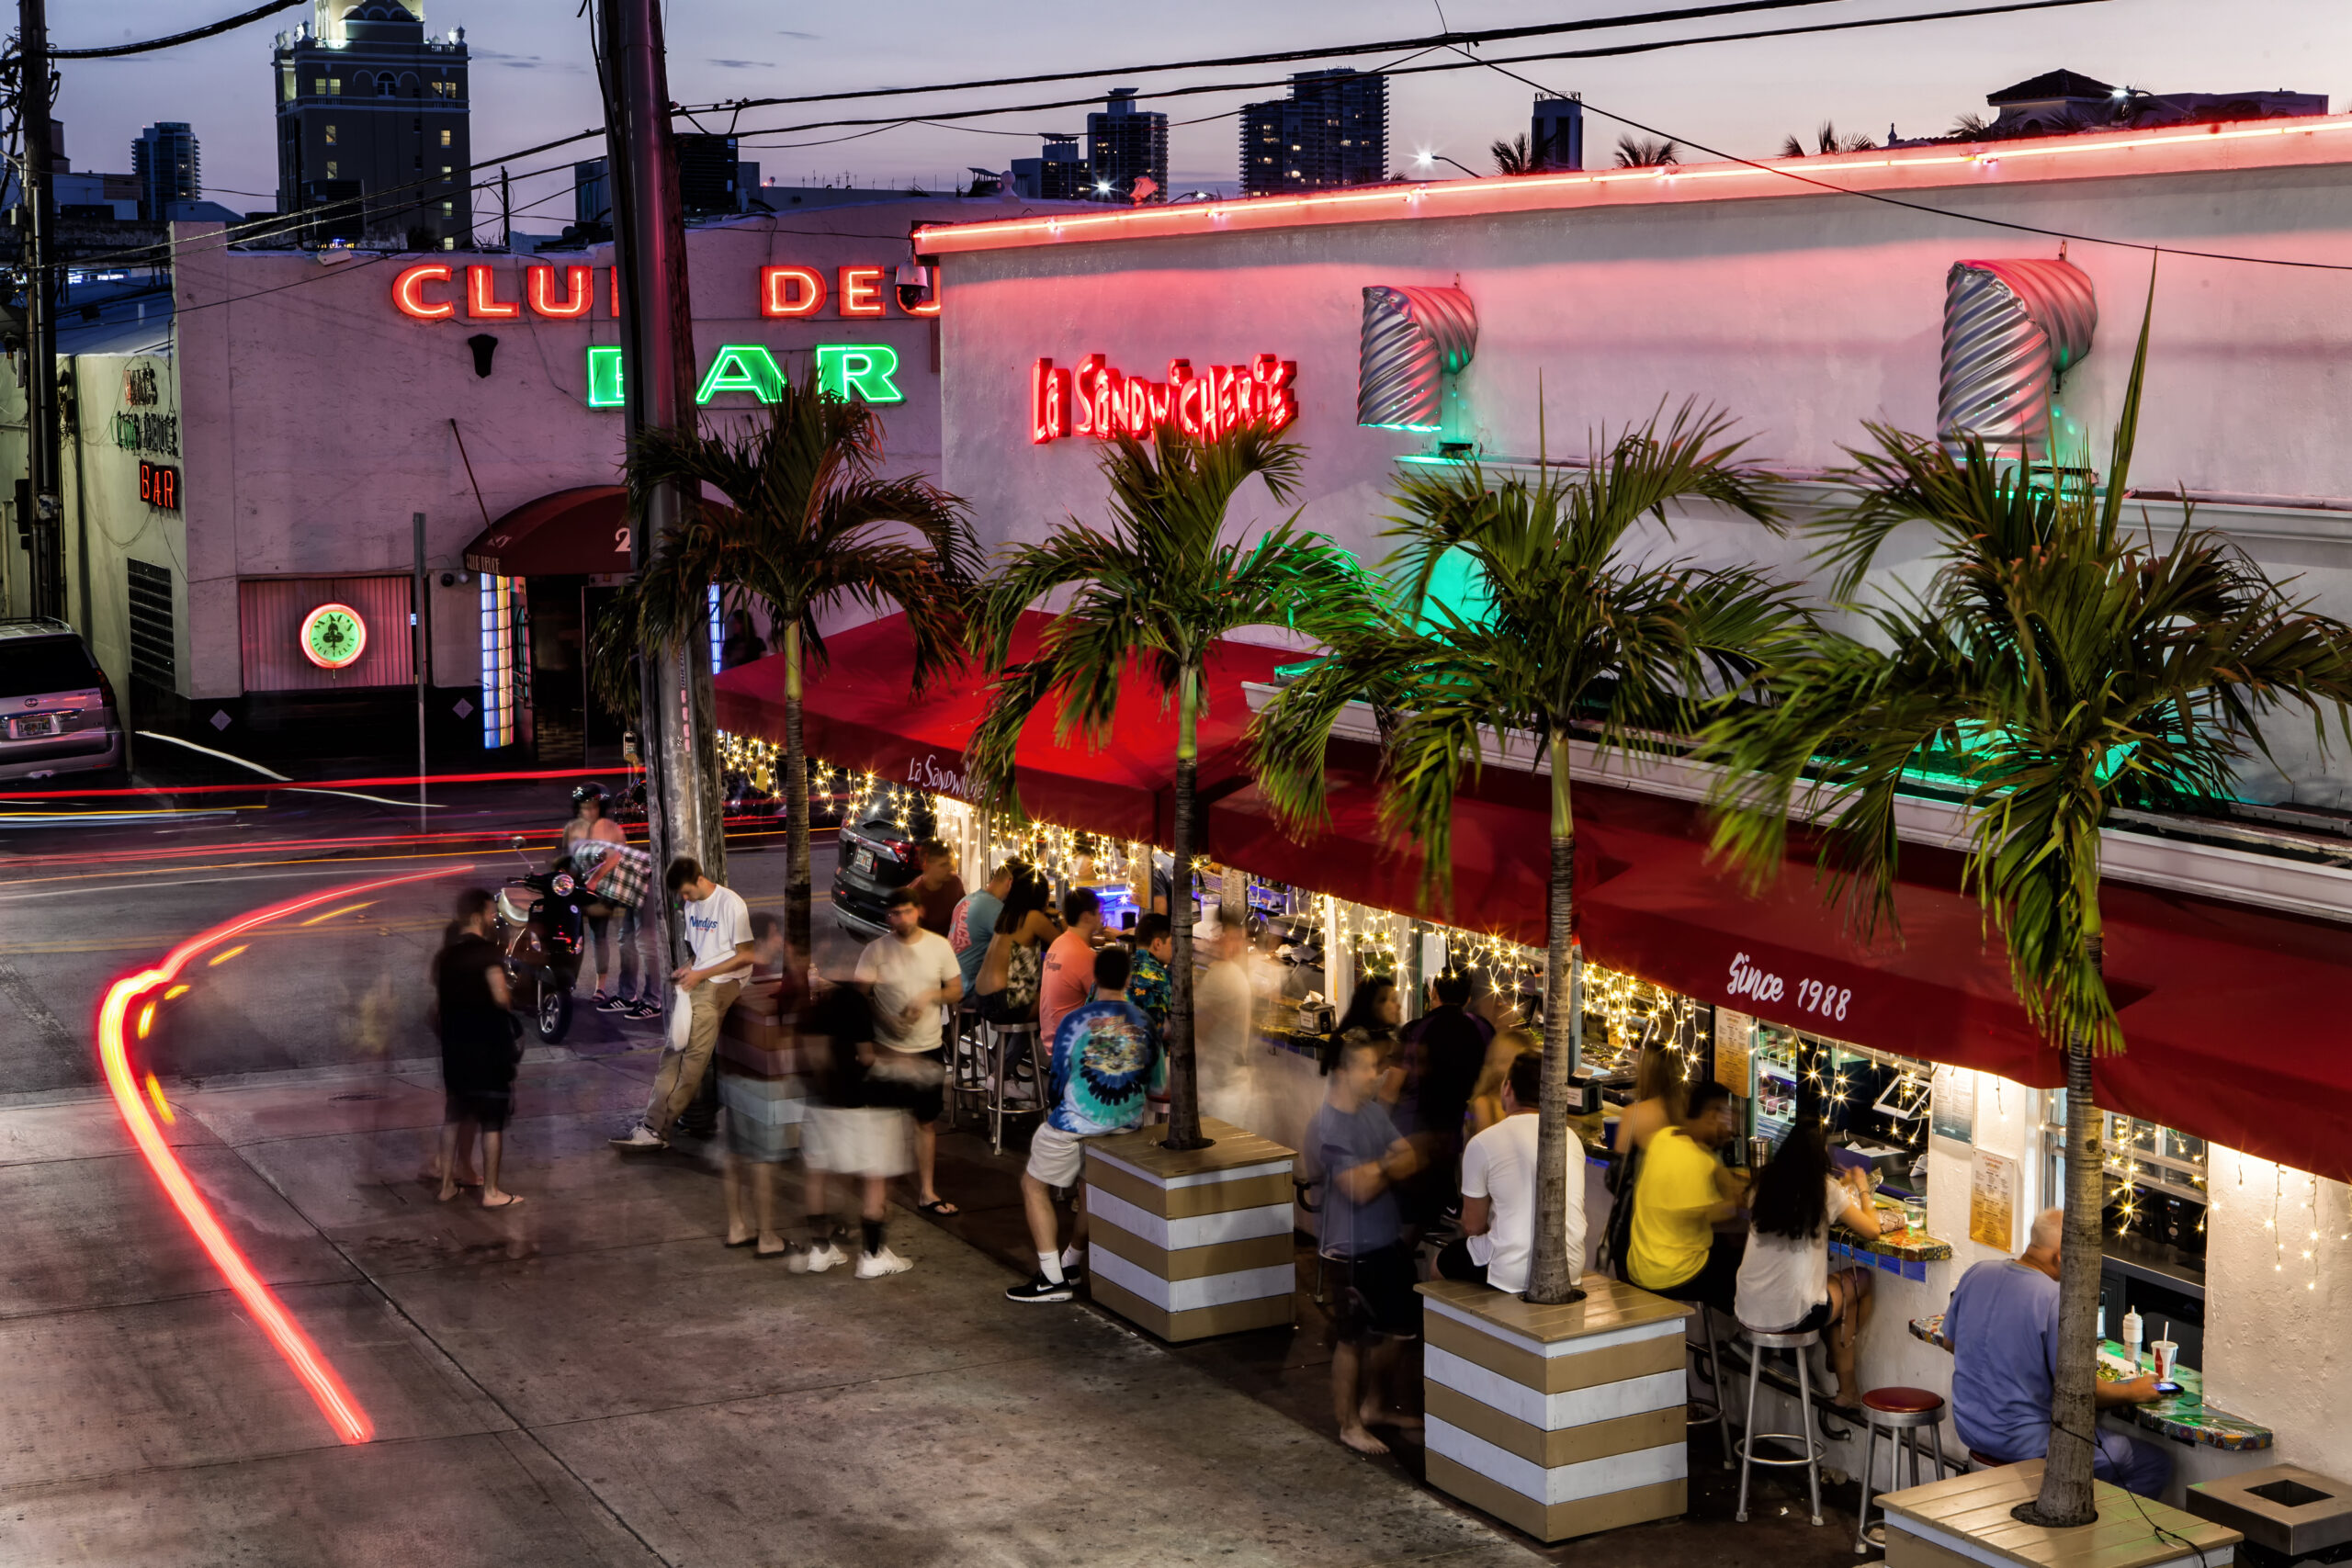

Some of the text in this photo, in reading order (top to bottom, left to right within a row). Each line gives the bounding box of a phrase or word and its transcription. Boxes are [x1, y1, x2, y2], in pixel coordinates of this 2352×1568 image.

[392, 264, 620, 318] CLU
[141, 464, 175, 508] BAR
[907, 757, 922, 783] La
[1726, 952, 1851, 1021] Since 1988
